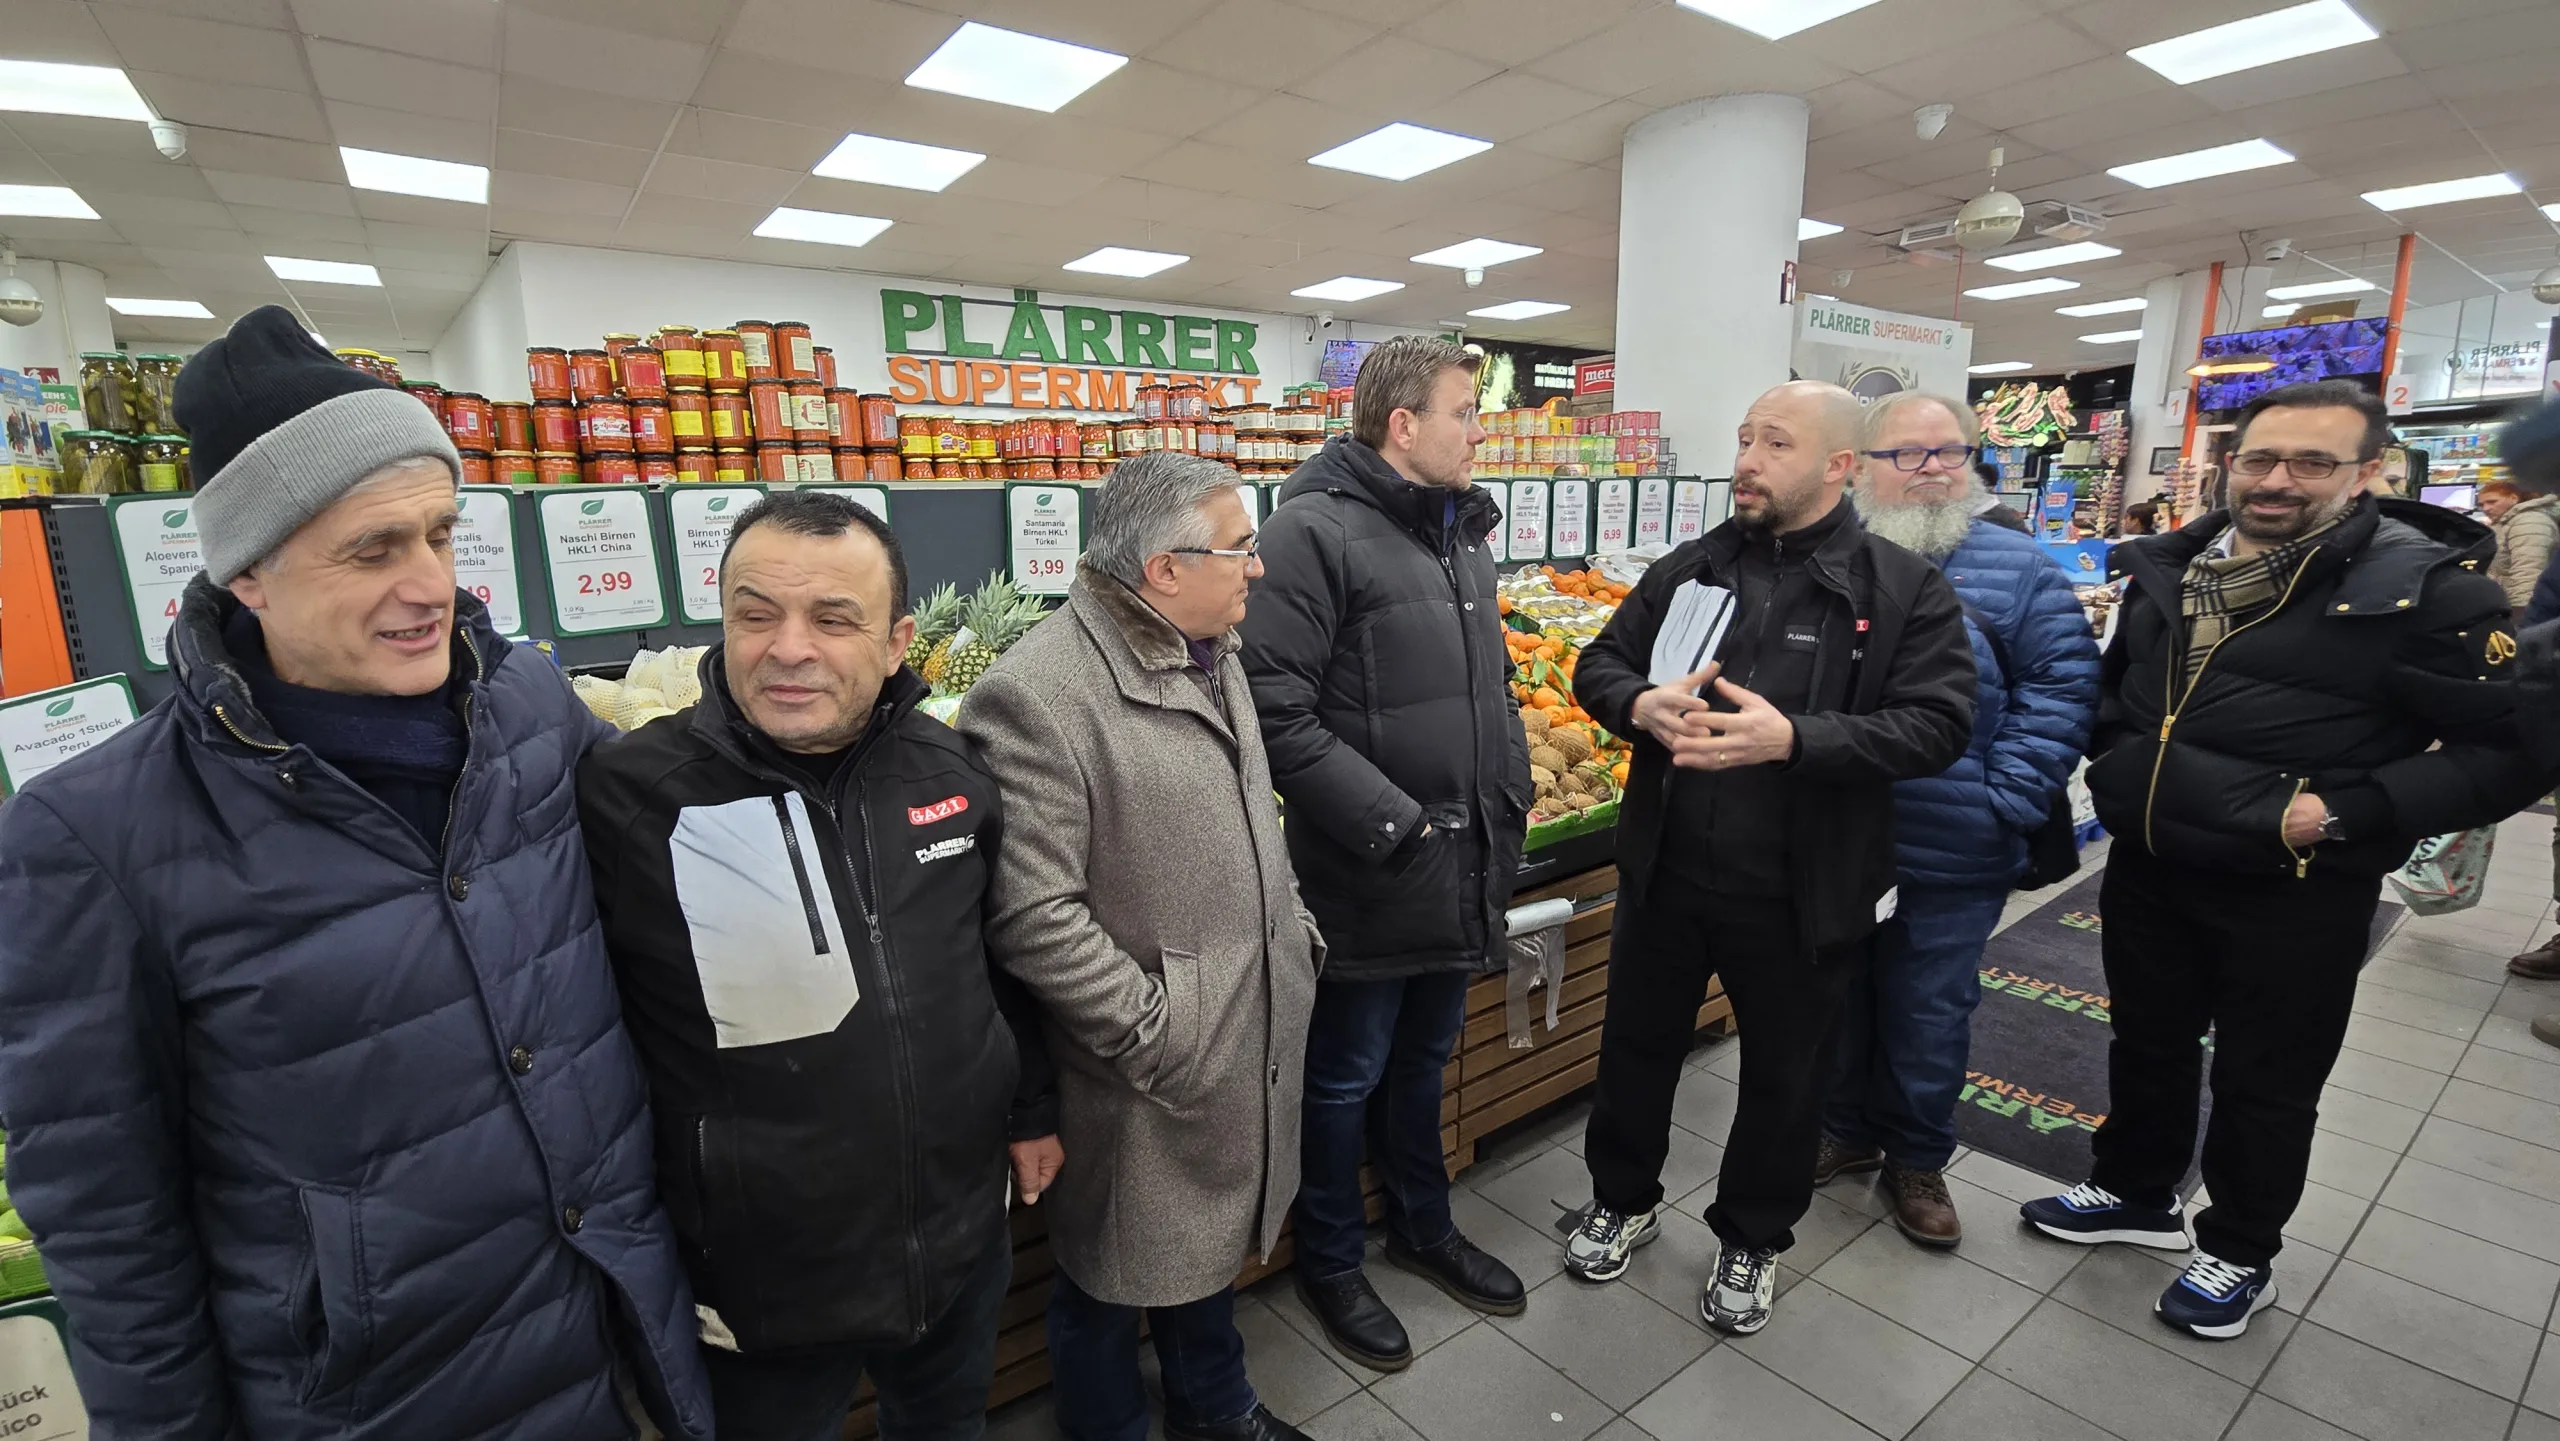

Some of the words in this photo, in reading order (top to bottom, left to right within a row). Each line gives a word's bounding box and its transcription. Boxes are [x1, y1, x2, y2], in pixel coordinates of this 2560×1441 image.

[880, 289, 1260, 375] PLÄRRER
[1810, 308, 1871, 336] PLÄRRER
[1873, 320, 1943, 346] SUPERMARKT
[2392, 386, 2408, 405] 2
[2171, 398, 2180, 416] 1
[1025, 519, 1065, 527] Santamaria
[1642, 522, 1659, 534] 6,99
[560, 533, 598, 544] Naschi
[600, 532, 636, 541] Birnen
[687, 527, 721, 538] Birnen
[1517, 528, 1537, 541] 2,99
[1559, 530, 1578, 543] 0,99
[1603, 528, 1621, 541] 6,99
[568, 545, 597, 555] HKL1
[600, 543, 632, 553] China
[693, 539, 720, 548] HKL1
[145, 550, 198, 562] Aloevera
[702, 567, 717, 585] 2
[1029, 559, 1064, 577] 3,99
[578, 571, 633, 596] 2,99
[467, 585, 491, 605] 9
[44, 713, 87, 729] PLÄRRER
[14, 732, 76, 753] Avacado
[79, 718, 123, 736] 1Stück
[59, 740, 91, 755] Peru
[911, 799, 962, 823] GAZI
[919, 846, 966, 864] SUPERMARKT
